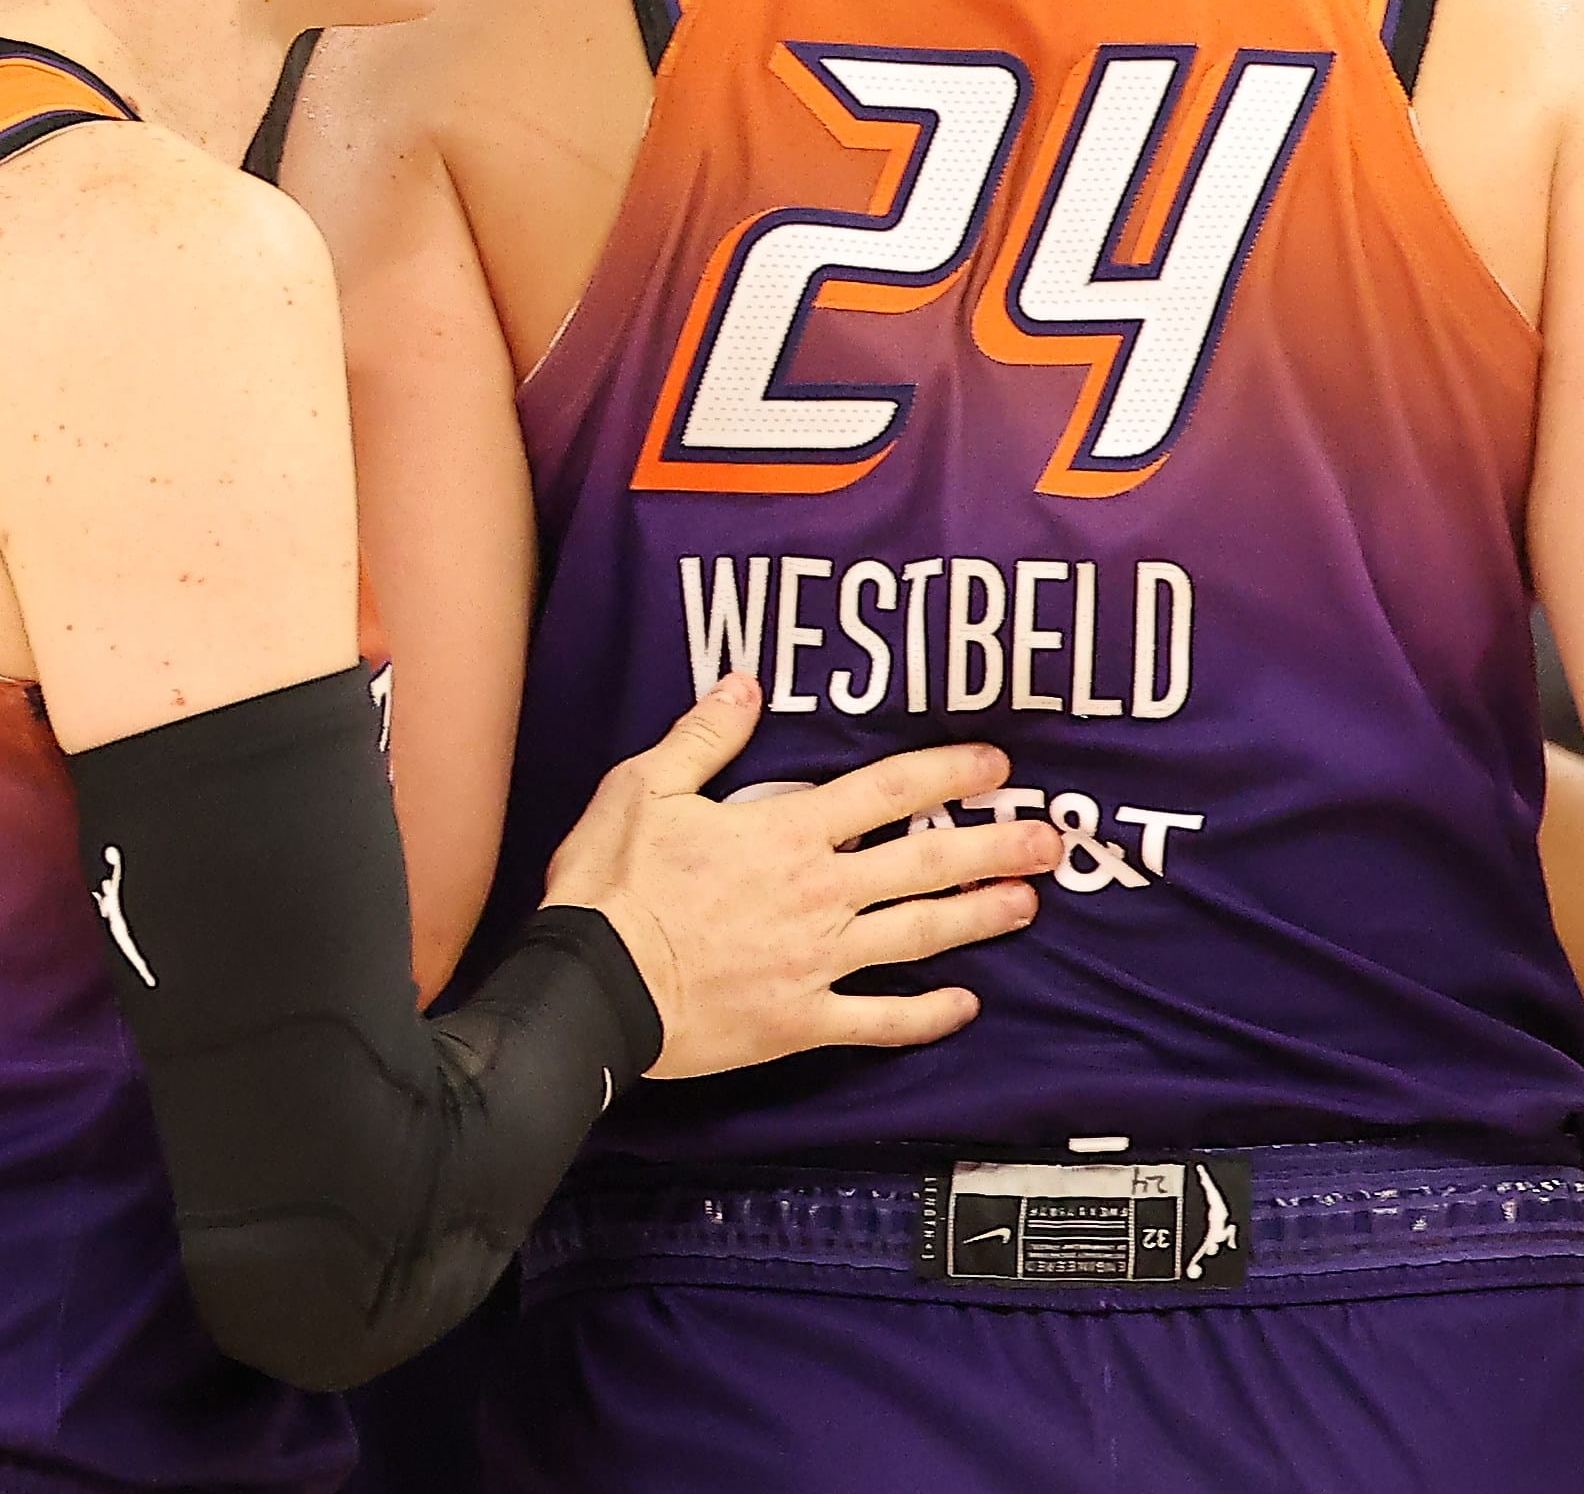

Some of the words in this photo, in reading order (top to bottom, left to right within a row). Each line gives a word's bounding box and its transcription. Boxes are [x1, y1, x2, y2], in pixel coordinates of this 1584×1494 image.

[630, 39, 1337, 500] 24
[677, 553, 1195, 721] WESTBELD
[1131, 1165, 1168, 1196] 24
[1141, 1227, 1171, 1249] 32
